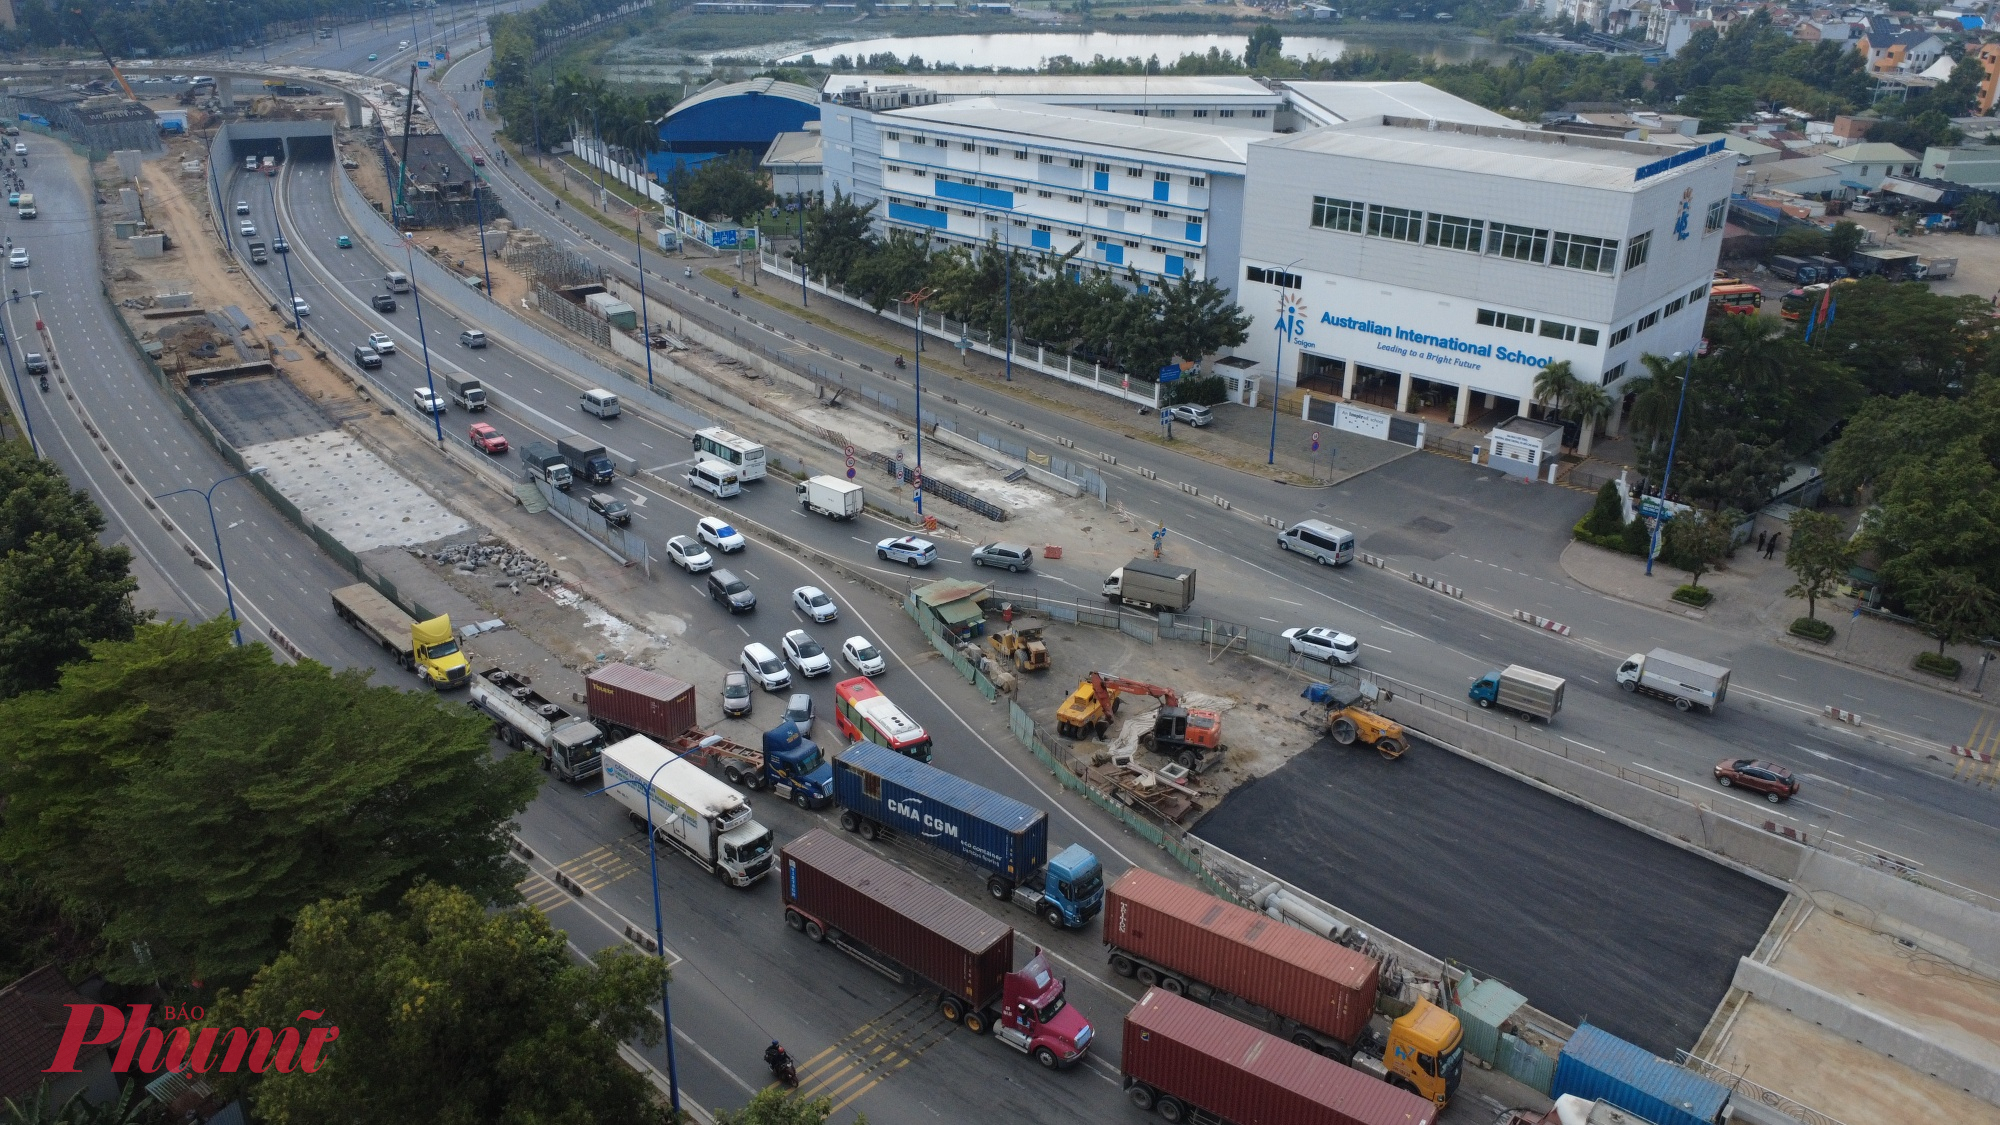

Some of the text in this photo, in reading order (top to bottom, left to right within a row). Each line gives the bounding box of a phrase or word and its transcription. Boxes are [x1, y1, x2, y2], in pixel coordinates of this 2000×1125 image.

[1294, 338, 1315, 348] Saigon
[1320, 311, 1553, 368] Australian International School
[1377, 341, 1408, 356] Leading
[1409, 349, 1417, 357] to
[1426, 352, 1452, 364] Bright
[1453, 357, 1481, 370] Future
[887, 798, 958, 838] CMA CGM
[972, 845, 1003, 862] container
